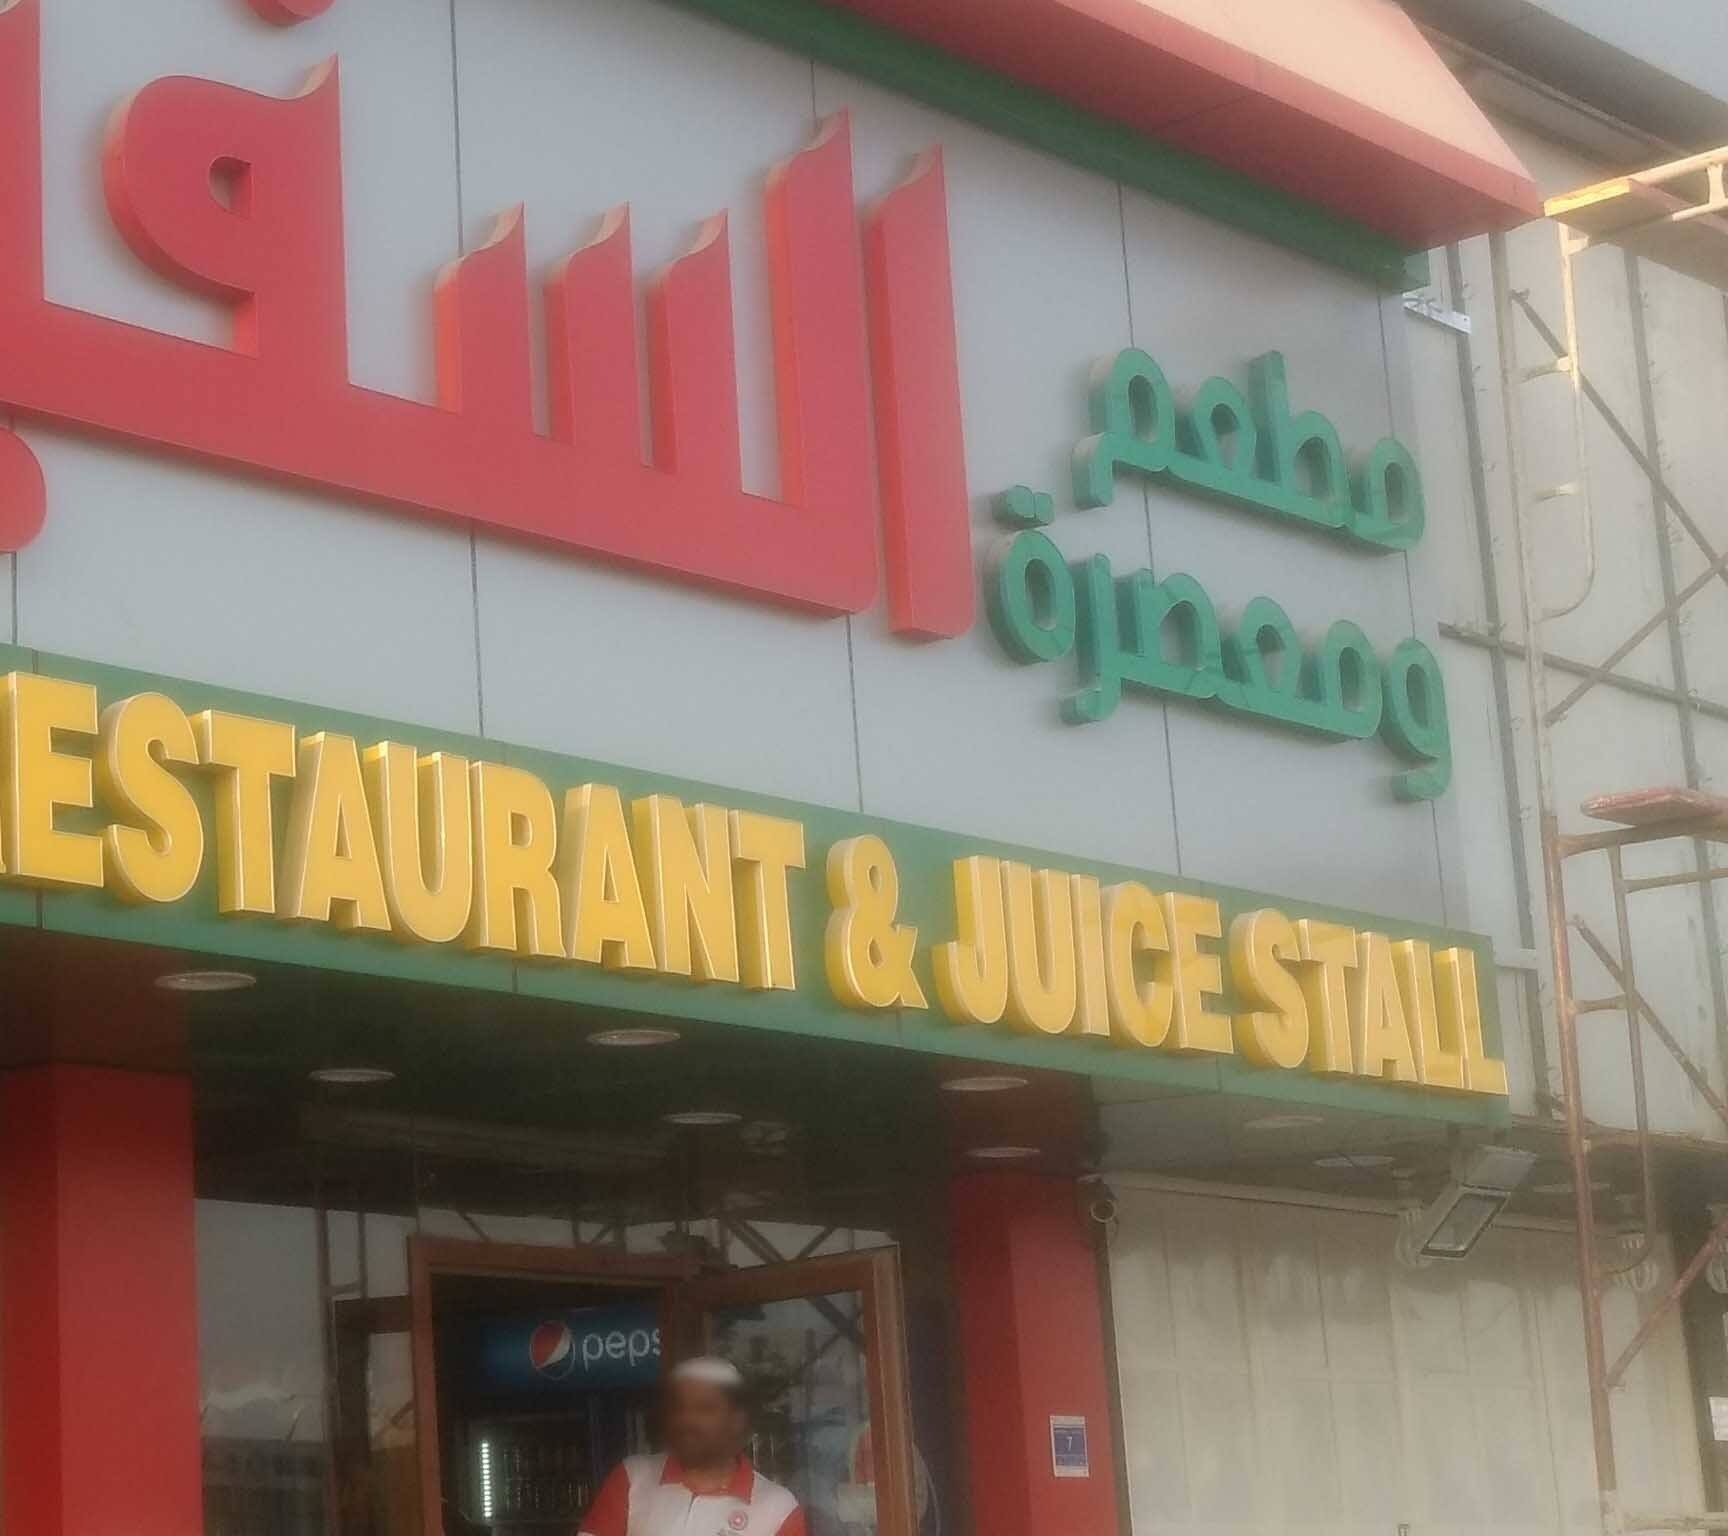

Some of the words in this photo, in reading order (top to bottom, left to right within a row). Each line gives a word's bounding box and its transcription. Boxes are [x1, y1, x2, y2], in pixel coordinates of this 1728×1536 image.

[1073, 346, 1426, 554] مطعم
[982, 483, 1454, 802] ومعصرة
[824, 833, 929, 1011] &
[932, 854, 1235, 1056] JUICE
[1229, 907, 1510, 1096] STALL
